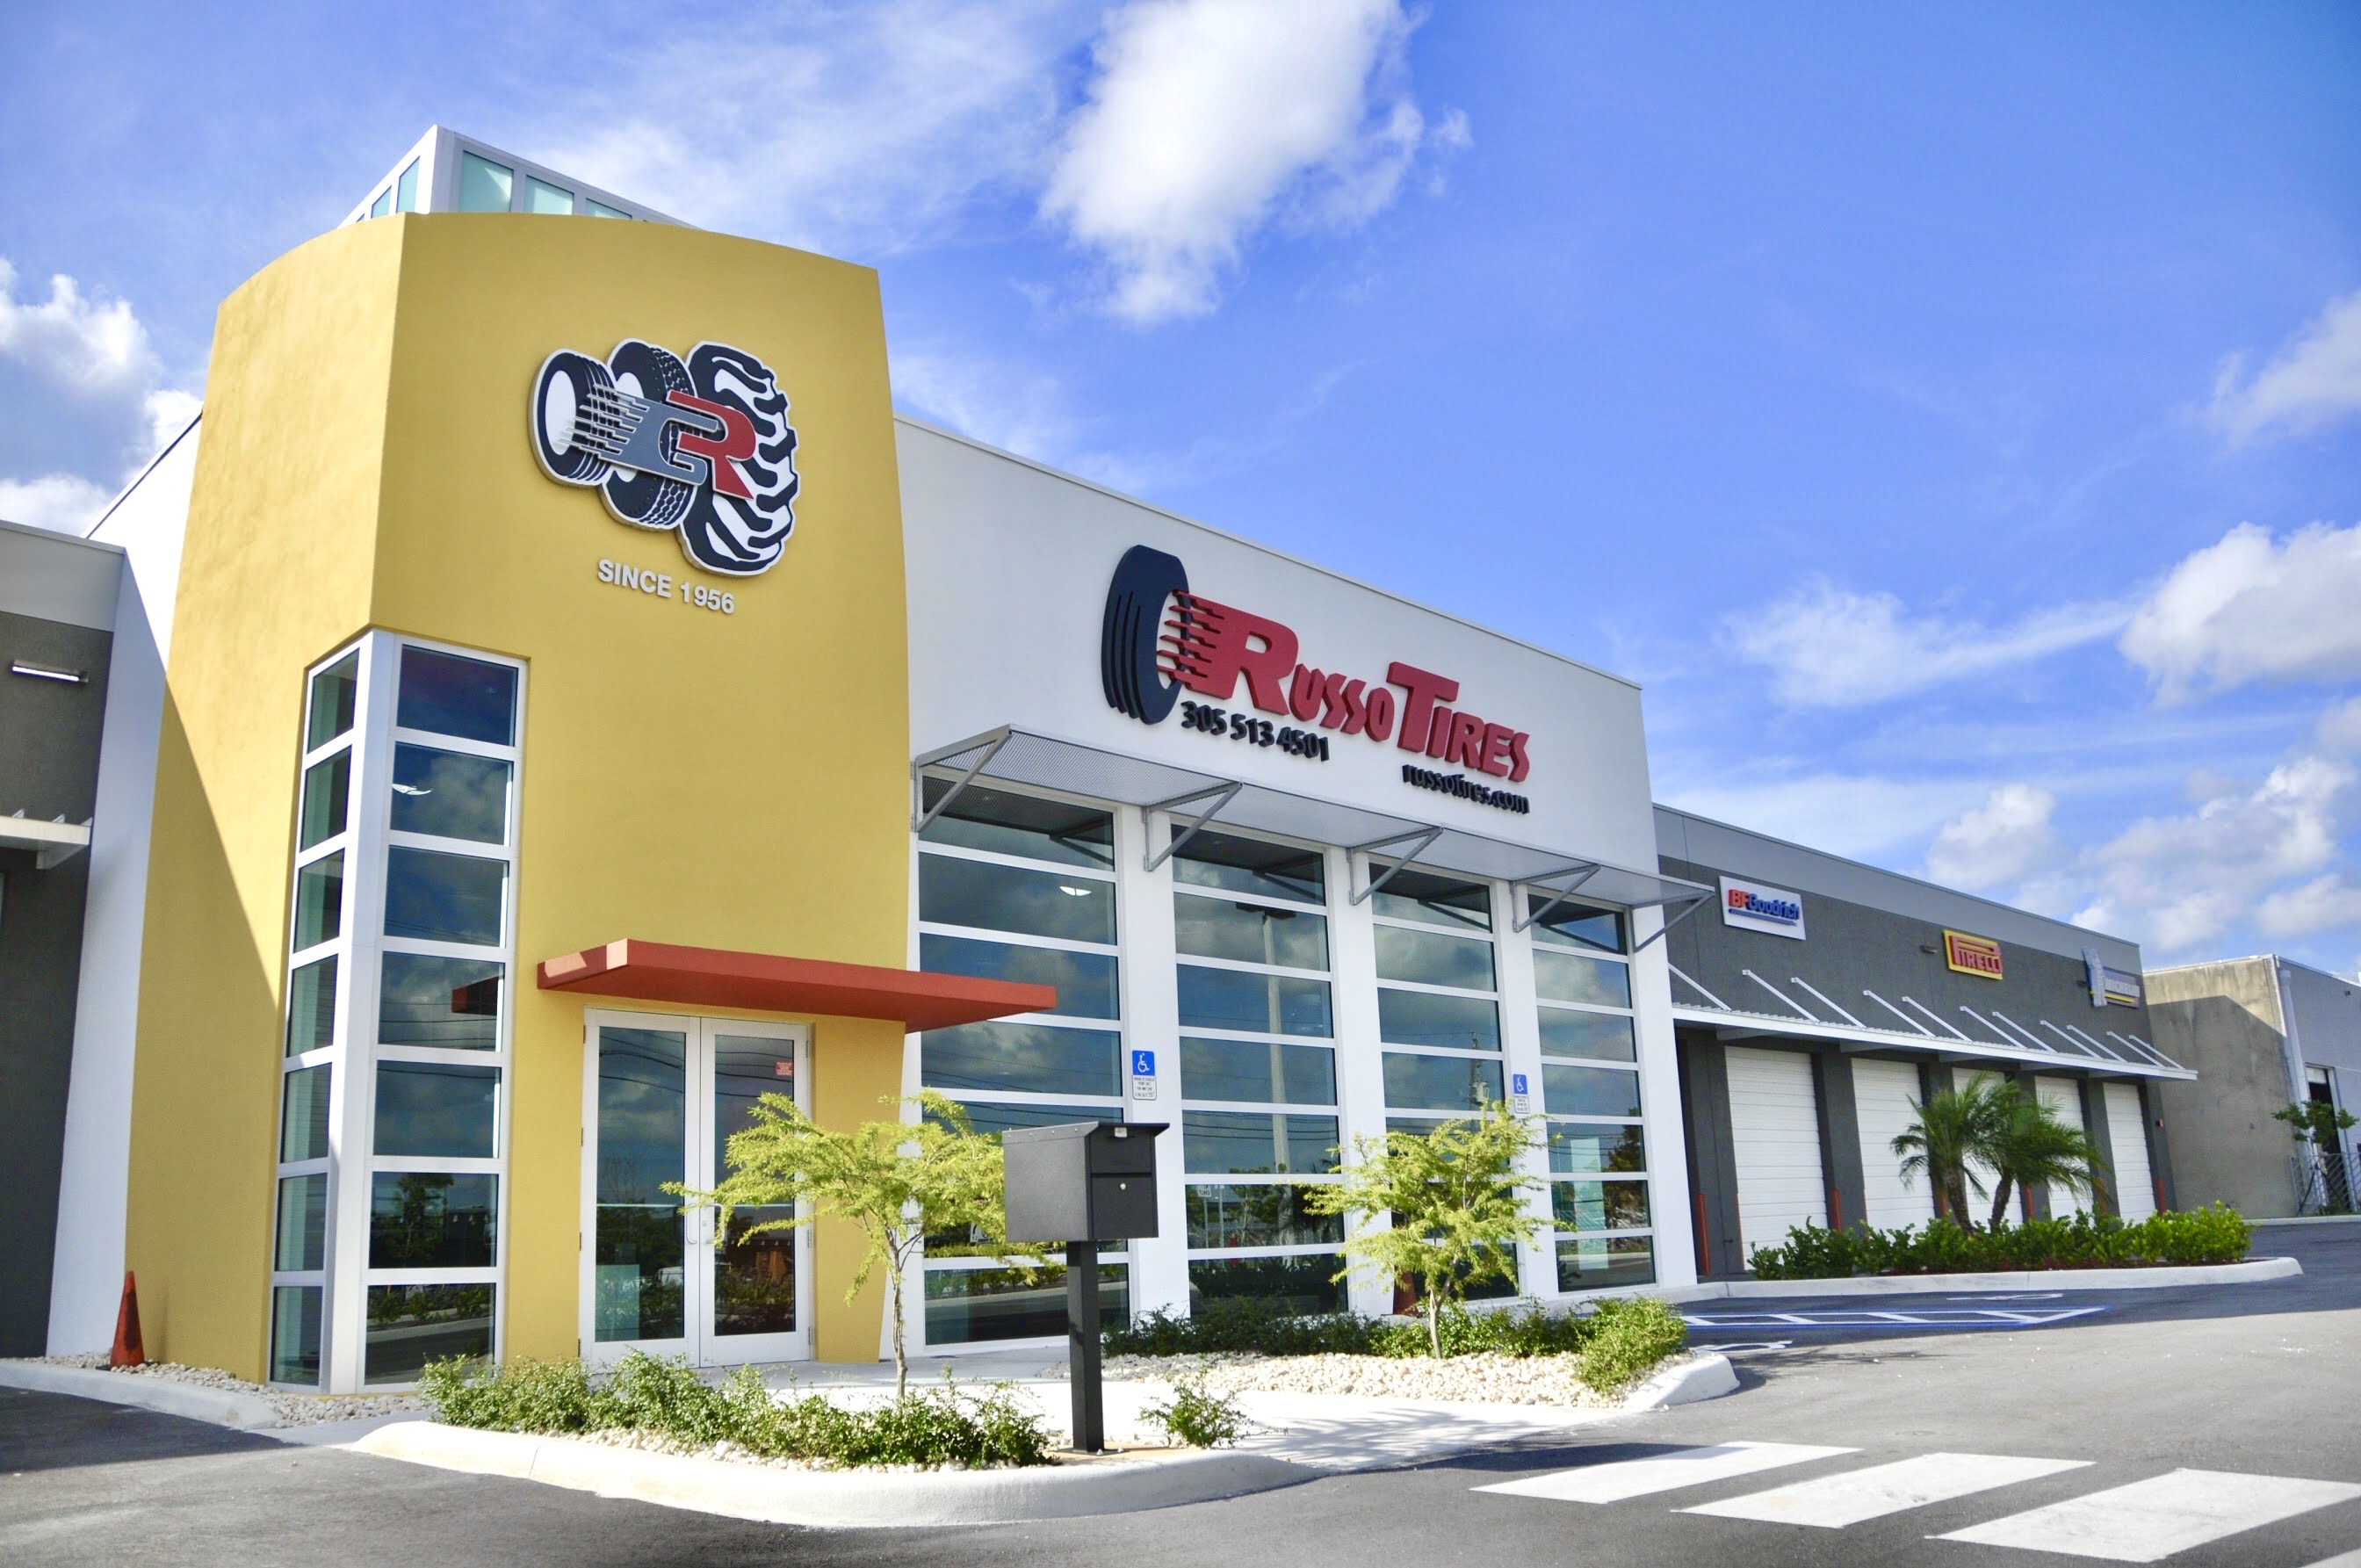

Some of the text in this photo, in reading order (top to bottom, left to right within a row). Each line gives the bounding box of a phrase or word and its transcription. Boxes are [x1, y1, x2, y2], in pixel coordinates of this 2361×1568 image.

[597, 559, 735, 614] SINCE 1956
[1180, 700, 1330, 762] 305 513 4501
[1402, 764, 1530, 814] russotires.com
[1948, 936, 2004, 974] PIRELLI
